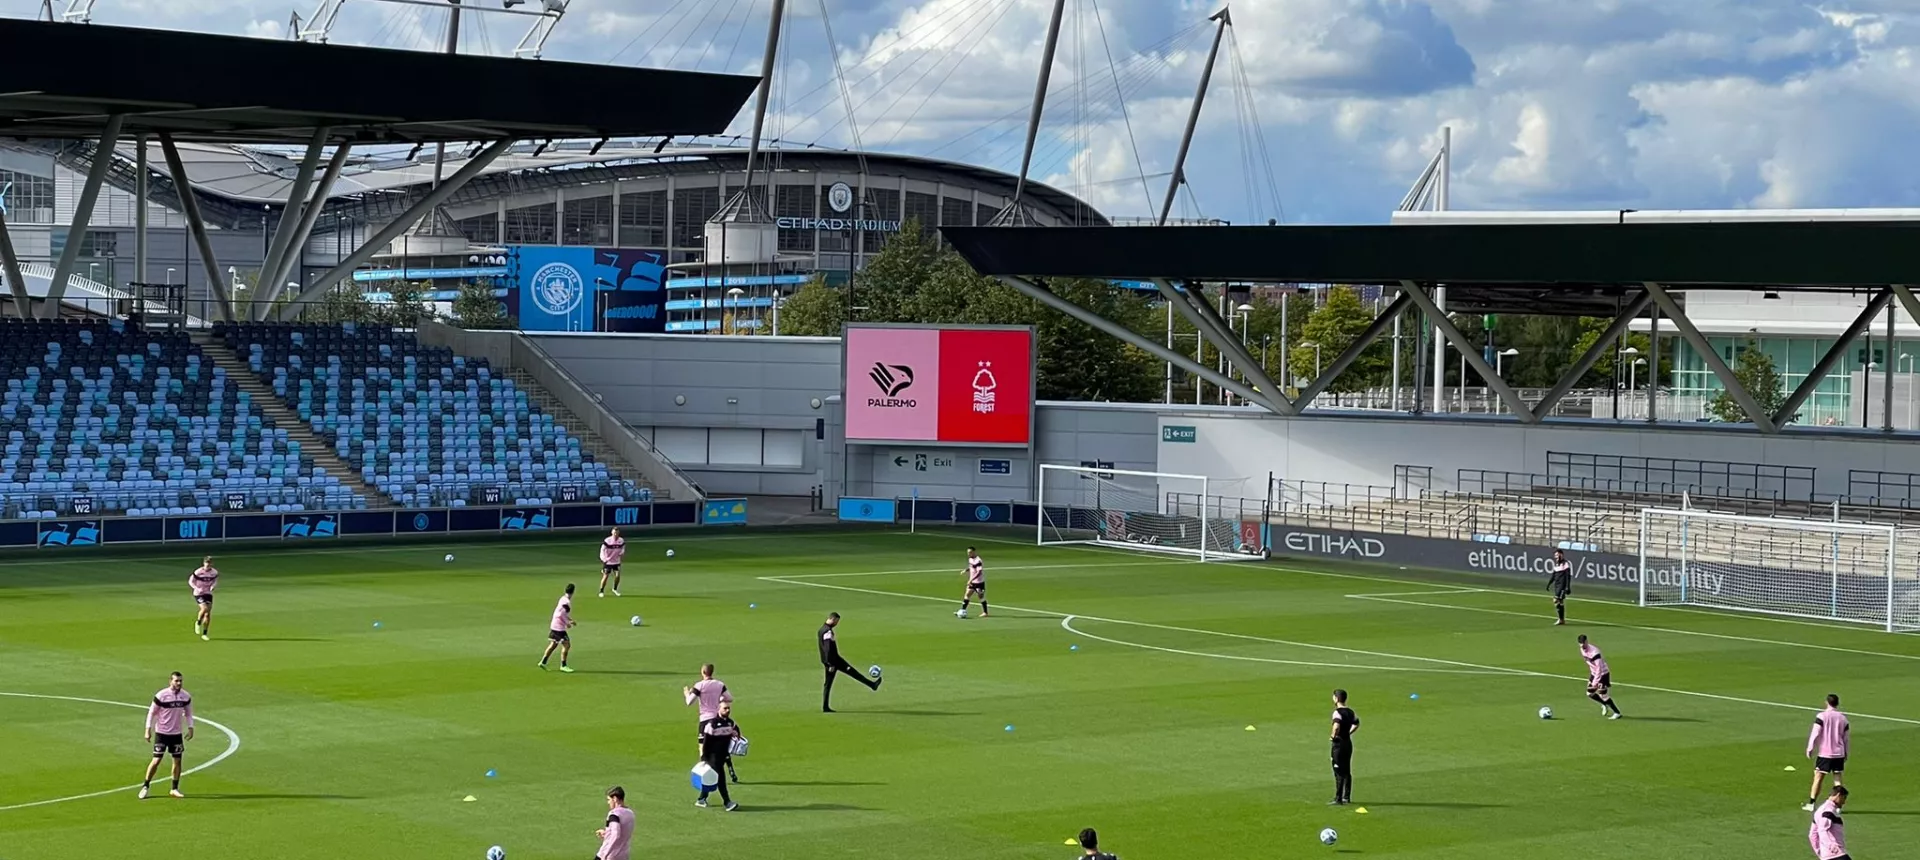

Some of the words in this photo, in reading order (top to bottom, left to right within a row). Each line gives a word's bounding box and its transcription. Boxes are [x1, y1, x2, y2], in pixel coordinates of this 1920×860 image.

[776, 217, 843, 230] ETIHAD
[844, 219, 901, 231] STADIUM
[868, 398, 917, 408] PALERMO
[973, 403, 995, 413] FOREST
[1180, 430, 1194, 438] EXIT
[933, 458, 952, 467] Exit
[486, 494, 498, 502] W1
[563, 492, 575, 500] W1
[75, 504, 90, 513] W2
[229, 500, 243, 509] W2
[615, 507, 640, 524] CITY
[179, 520, 209, 539] CITY
[1284, 532, 1385, 558] ETIHAD
[1468, 549, 1725, 595] etihad.co/sustanability
